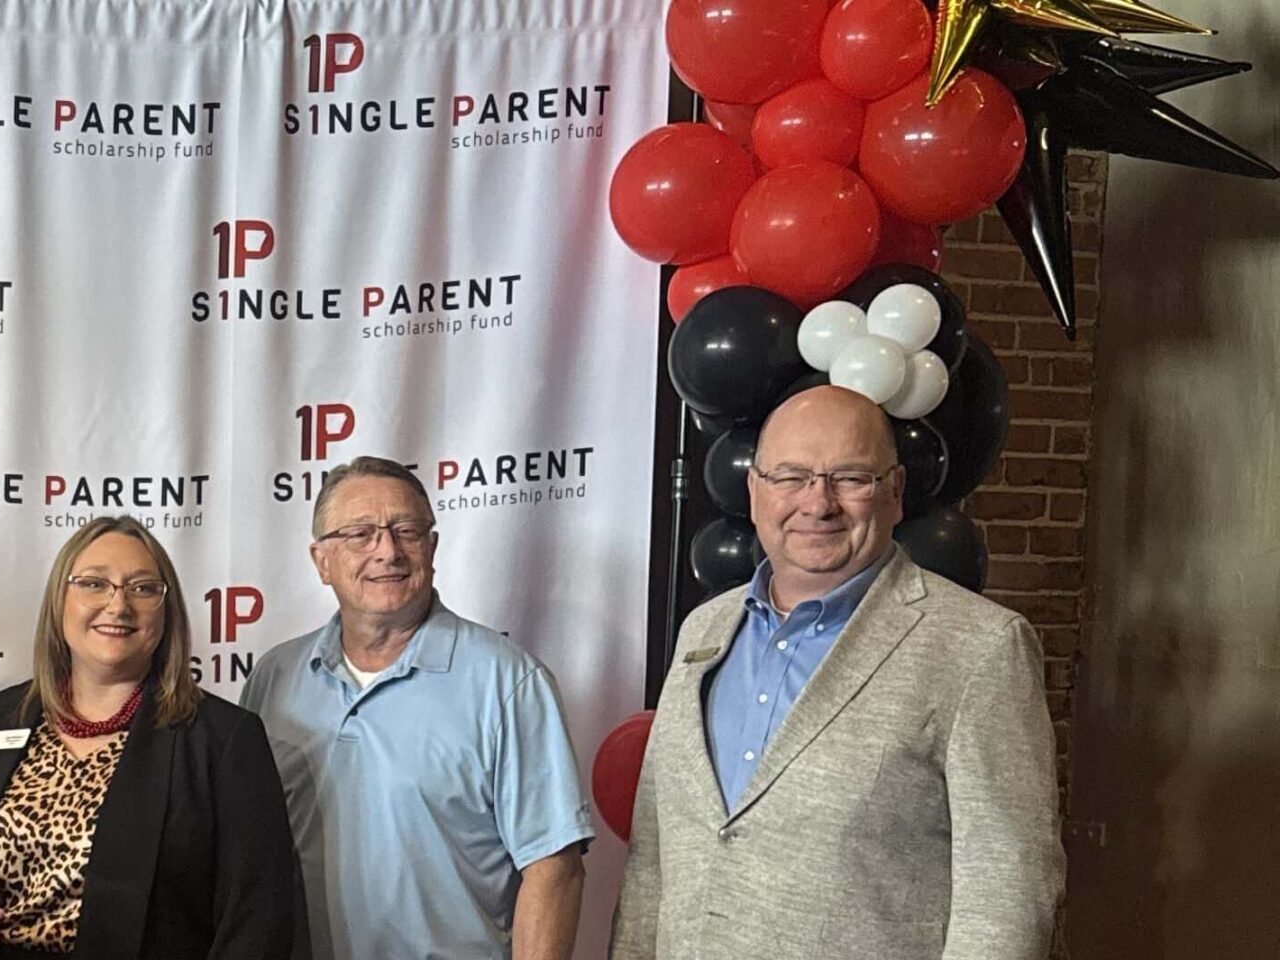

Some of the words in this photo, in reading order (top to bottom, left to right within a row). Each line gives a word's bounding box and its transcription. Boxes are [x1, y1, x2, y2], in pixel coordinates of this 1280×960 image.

[303, 32, 364, 93] 1P
[54, 100, 220, 136] PARENT
[452, 85, 610, 126] PARENT
[53, 139, 165, 161] scholarship
[175, 141, 213, 157] fund
[451, 124, 560, 148] scholarship
[568, 123, 603, 139] fund
[213, 220, 275, 279] 1P
[362, 274, 521, 317] PARENT
[362, 317, 462, 339] scholarship
[471, 311, 513, 330] fund
[296, 403, 355, 461] 1P
[438, 447, 594, 490] PARENT
[45, 475, 210, 507] PARENT
[437, 487, 542, 512] scholarship
[548, 483, 586, 500] fund
[44, 512, 154, 530] scholip
[163, 512, 203, 528] fund
[204, 586, 263, 643] 1P
